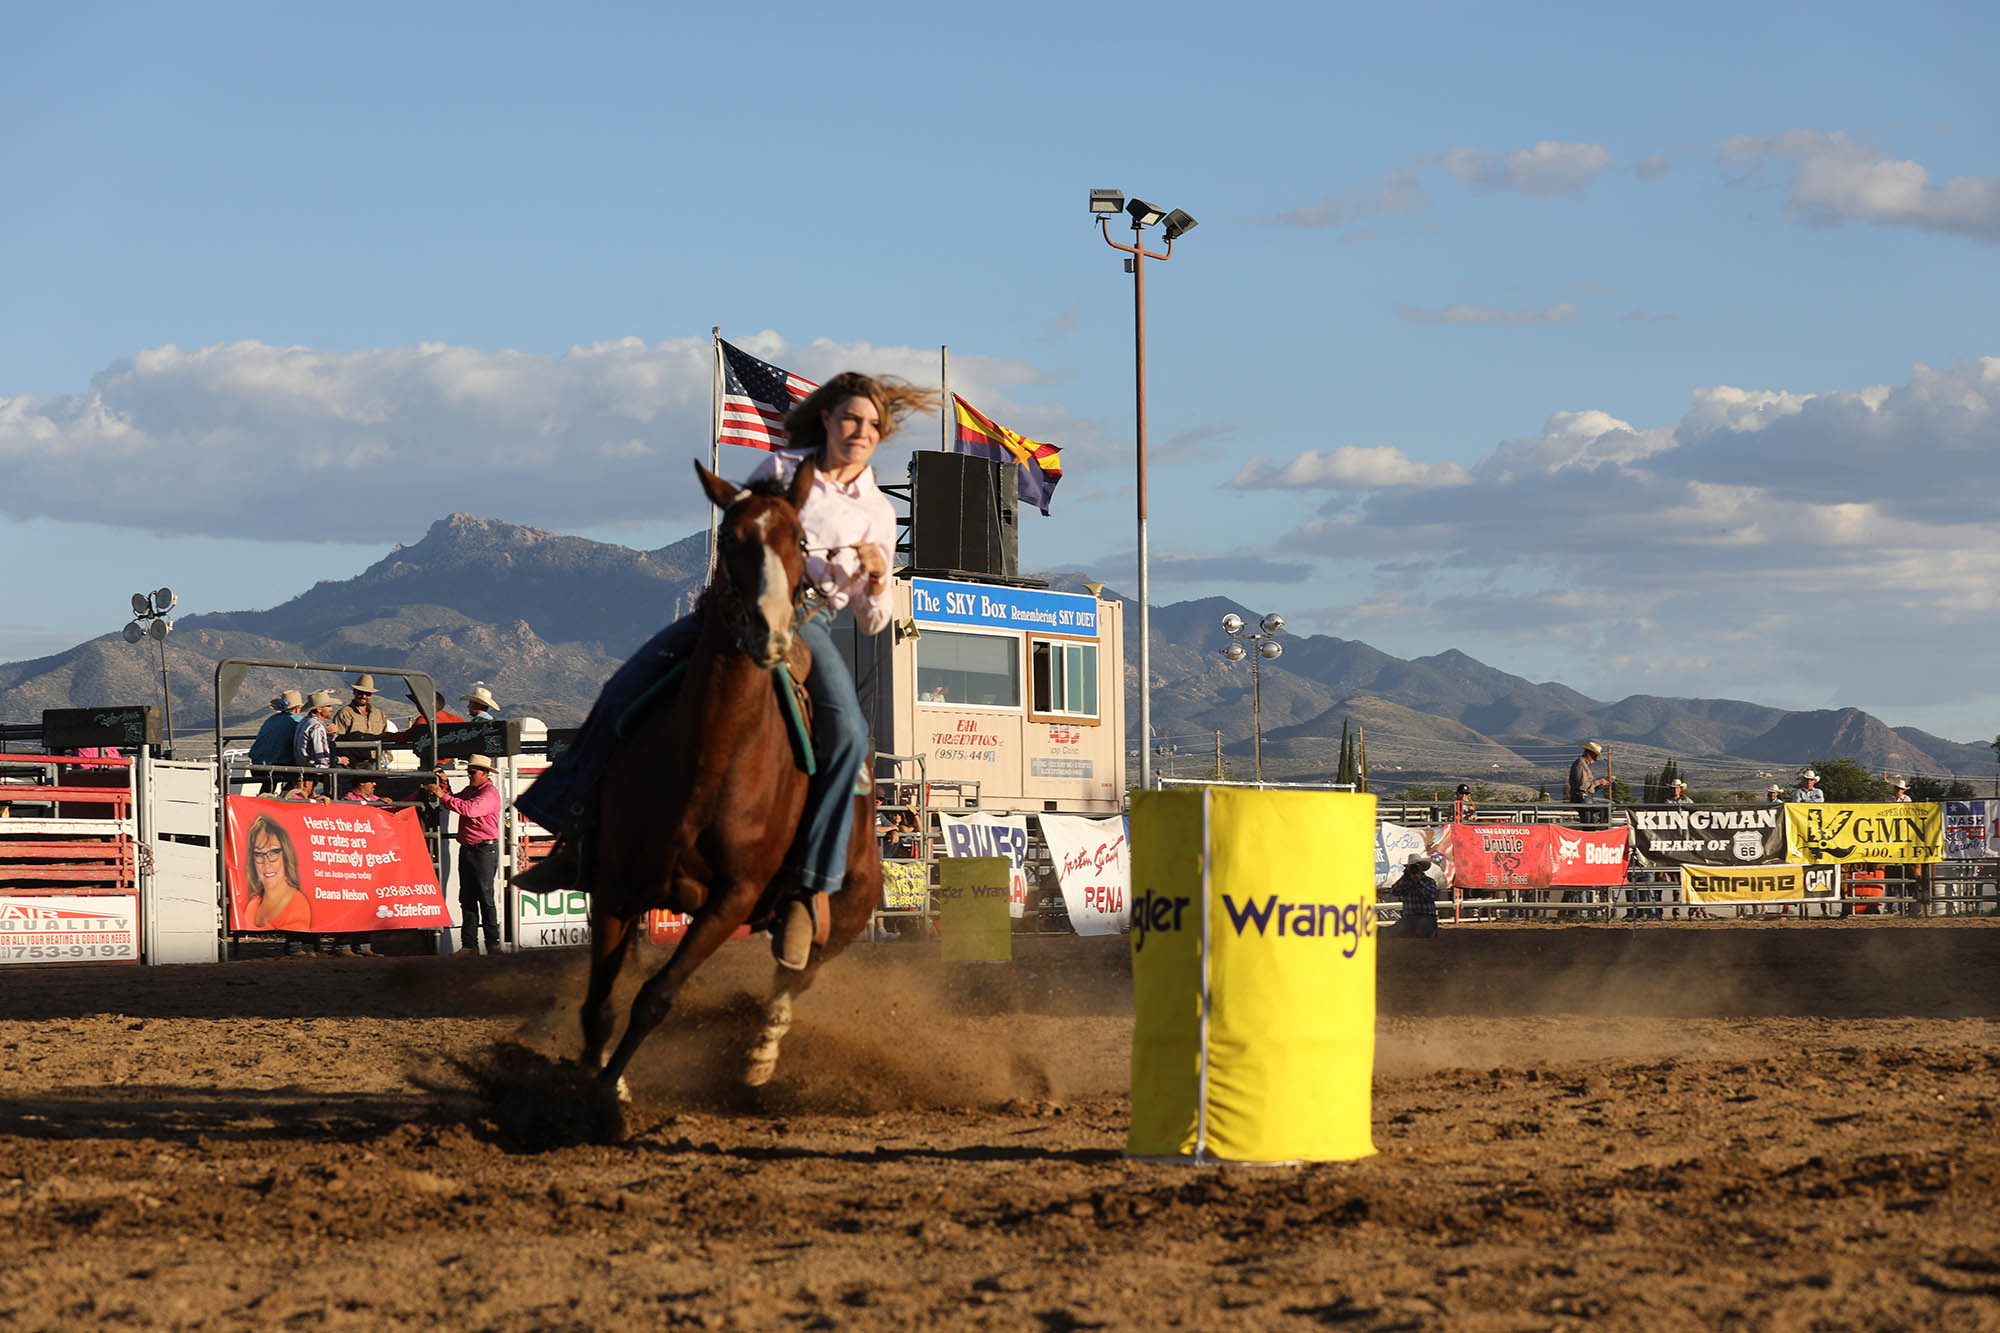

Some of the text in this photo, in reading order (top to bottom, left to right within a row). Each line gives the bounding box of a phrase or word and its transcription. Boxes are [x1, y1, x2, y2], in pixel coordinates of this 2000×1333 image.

[914, 589, 941, 612] The
[946, 592, 977, 615] SKY
[981, 596, 1007, 619] Box
[1011, 605, 1057, 627] Remembering
[1059, 610, 1074, 625] SKY
[303, 816, 375, 835] Here's the deal,
[1635, 810, 1777, 830] KINGMAN
[1948, 816, 1985, 825] NASH
[310, 834, 367, 848] our rates are
[1483, 835, 1523, 852] Double
[1649, 840, 1730, 851] HEART OF
[312, 849, 401, 867] surprisingly great.
[1741, 847, 1756, 857] 66
[1912, 846, 1941, 858] FM
[1805, 869, 1833, 892] CAT
[315, 888, 369, 901] Deana Nelson
[0, 920, 128, 930] QUALITY
[12, 936, 25, 945] ALL
[26, 935, 44, 945] YOUR
[46, 935, 74, 944] HEATING
[82, 935, 110, 944] COOLING
[111, 934, 131, 944] NEEDS
